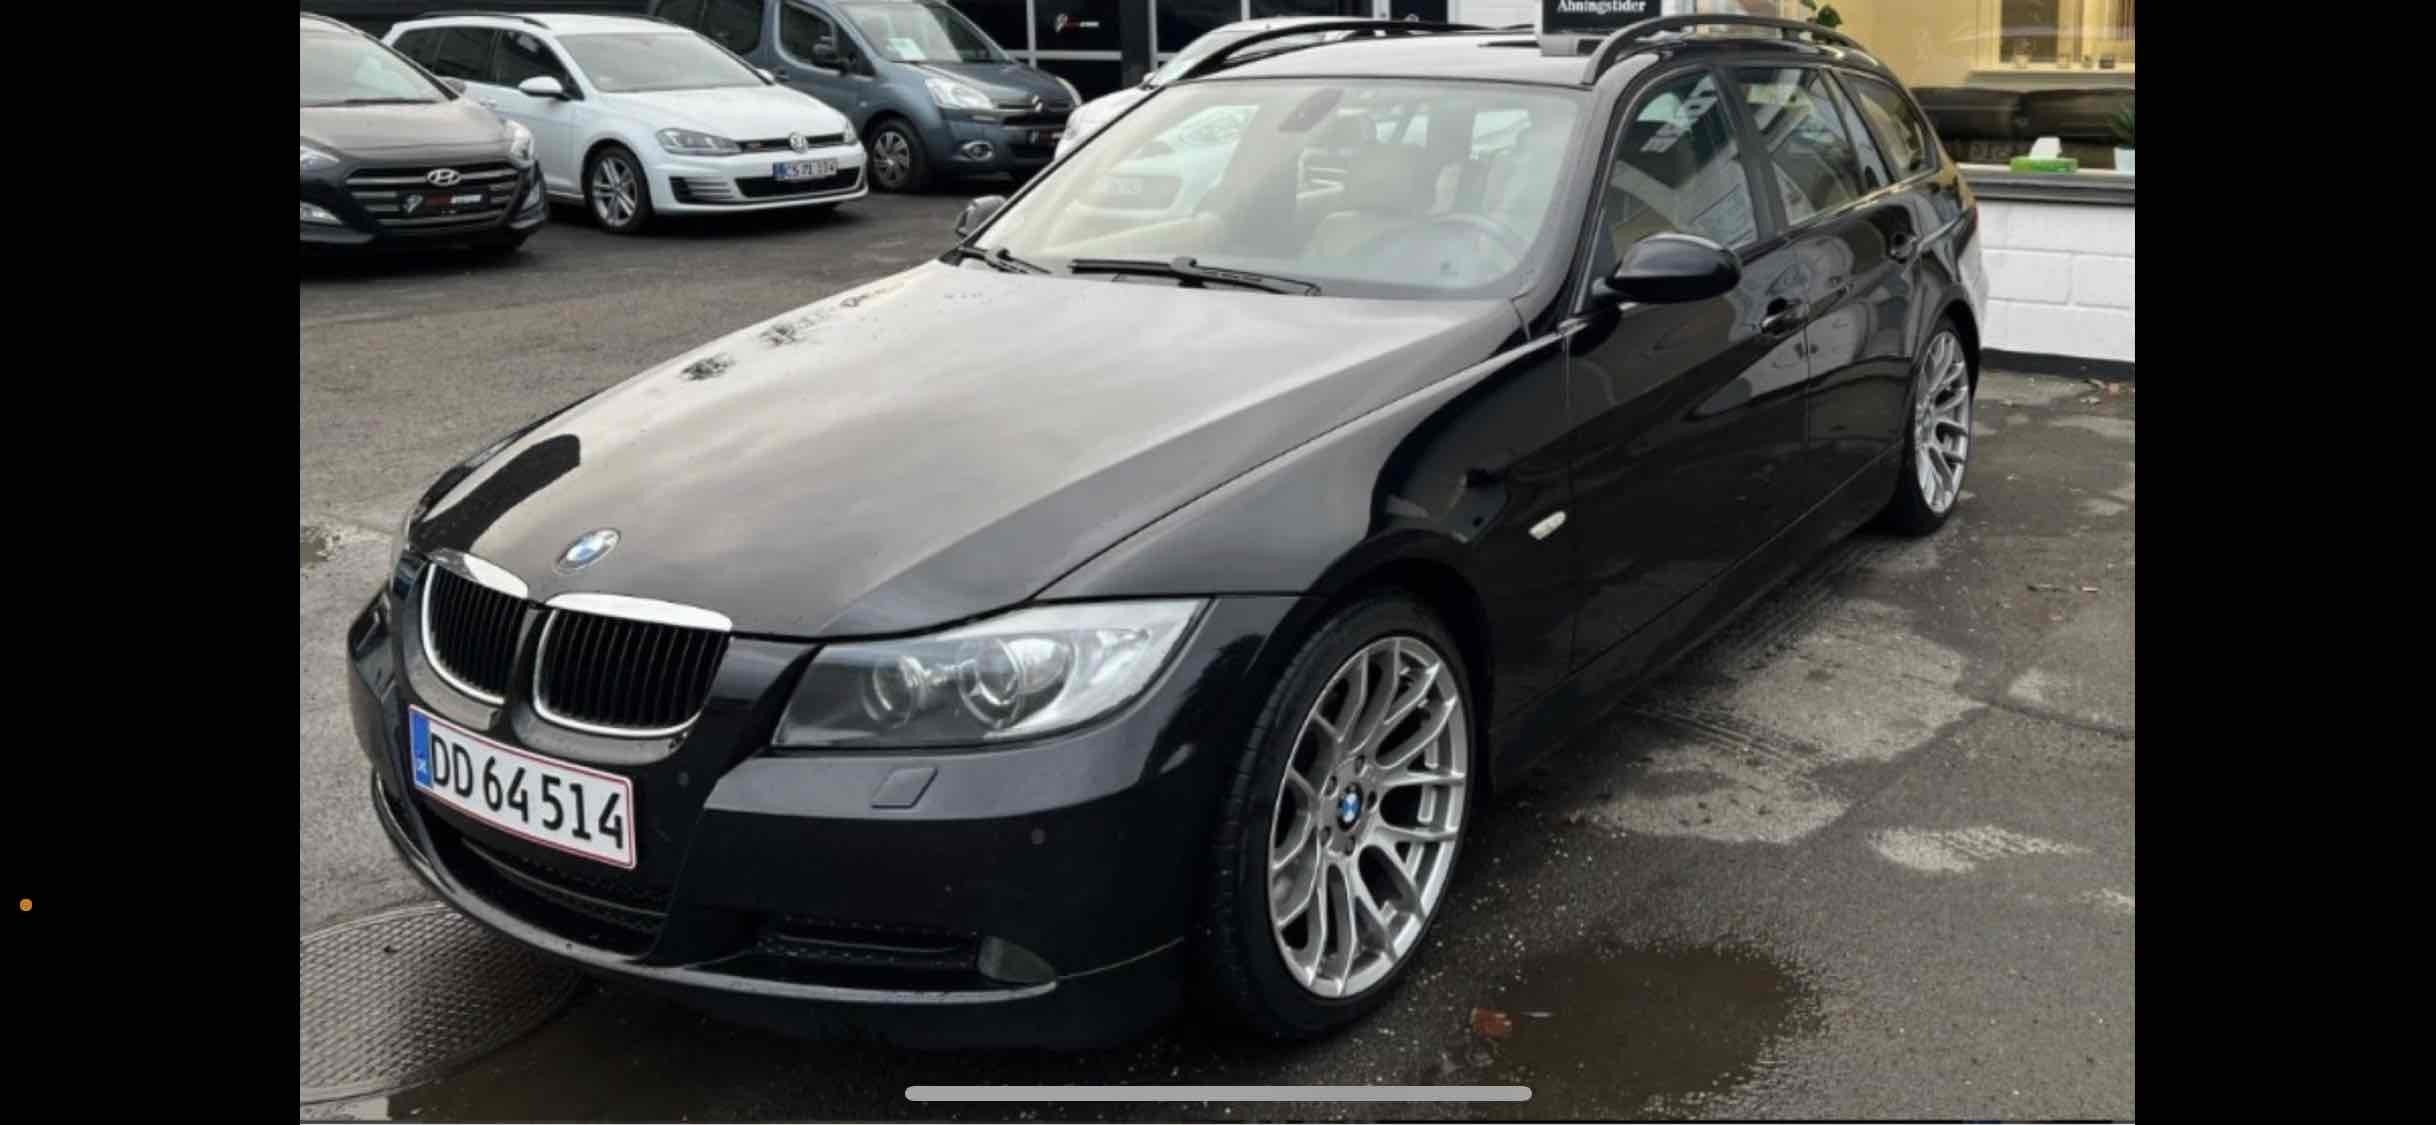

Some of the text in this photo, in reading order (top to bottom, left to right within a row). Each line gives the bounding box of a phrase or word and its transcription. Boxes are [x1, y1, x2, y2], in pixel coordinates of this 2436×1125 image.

[431, 732, 624, 850] DD 64 514
